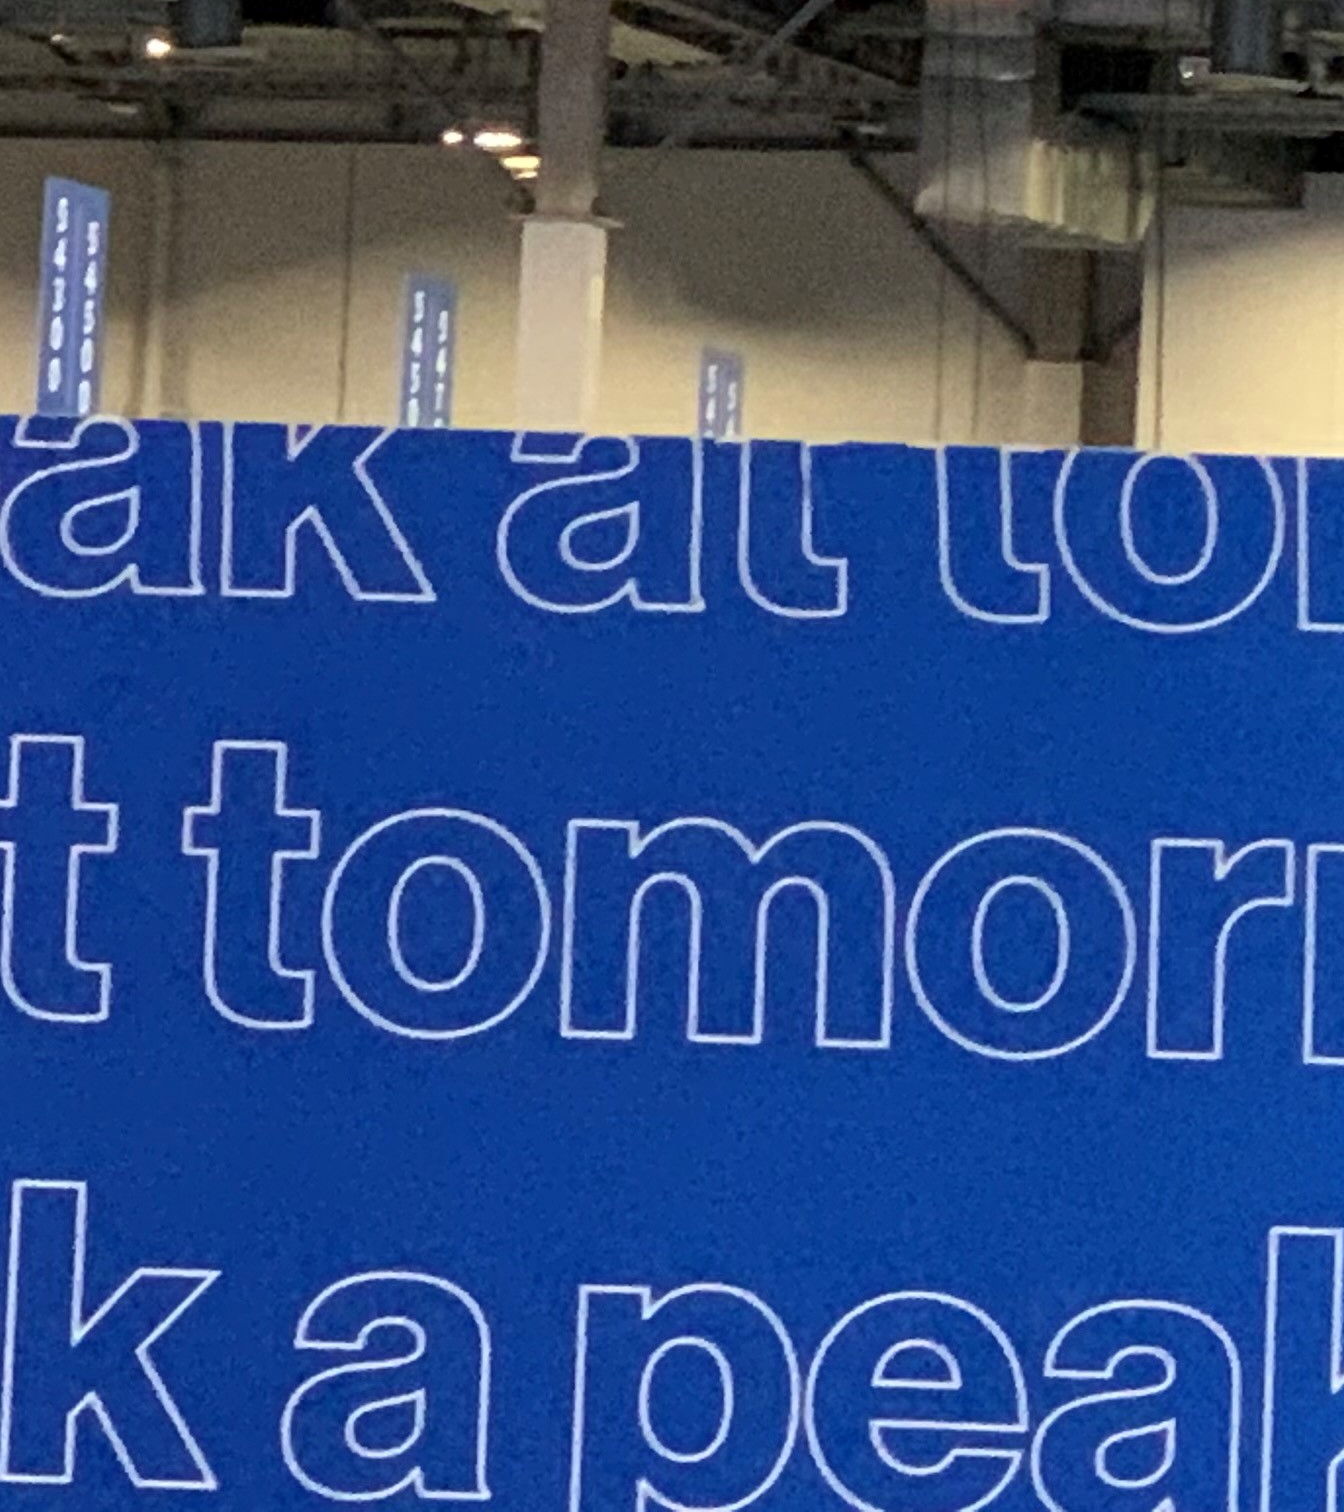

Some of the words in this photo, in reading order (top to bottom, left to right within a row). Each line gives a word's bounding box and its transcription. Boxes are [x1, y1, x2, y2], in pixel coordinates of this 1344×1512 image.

[497, 433, 847, 619] at
[2, 1179, 221, 1490] k
[281, 1271, 492, 1501] a
